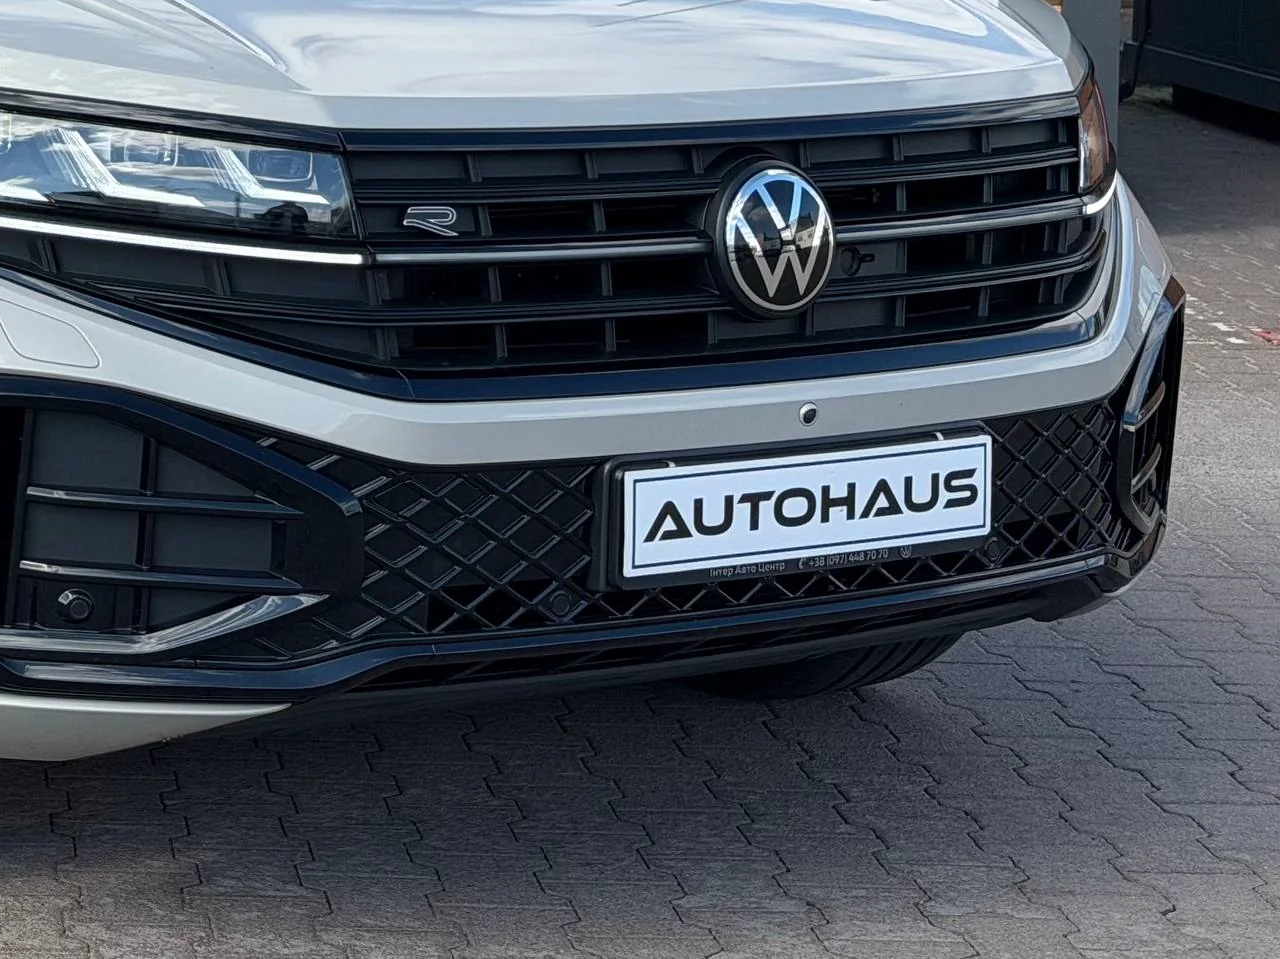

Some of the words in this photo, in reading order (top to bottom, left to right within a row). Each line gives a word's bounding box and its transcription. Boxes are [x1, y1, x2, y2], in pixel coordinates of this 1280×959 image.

[403, 206, 458, 236] R
[643, 468, 977, 543] AUTOHAUS
[735, 565, 756, 574] Авто
[758, 562, 785, 573] Центр
[808, 556, 825, 567] +38
[826, 553, 848, 566] (097)
[849, 551, 865, 562] 448
[866, 550, 877, 560] 70
[878, 548, 889, 559] 70
